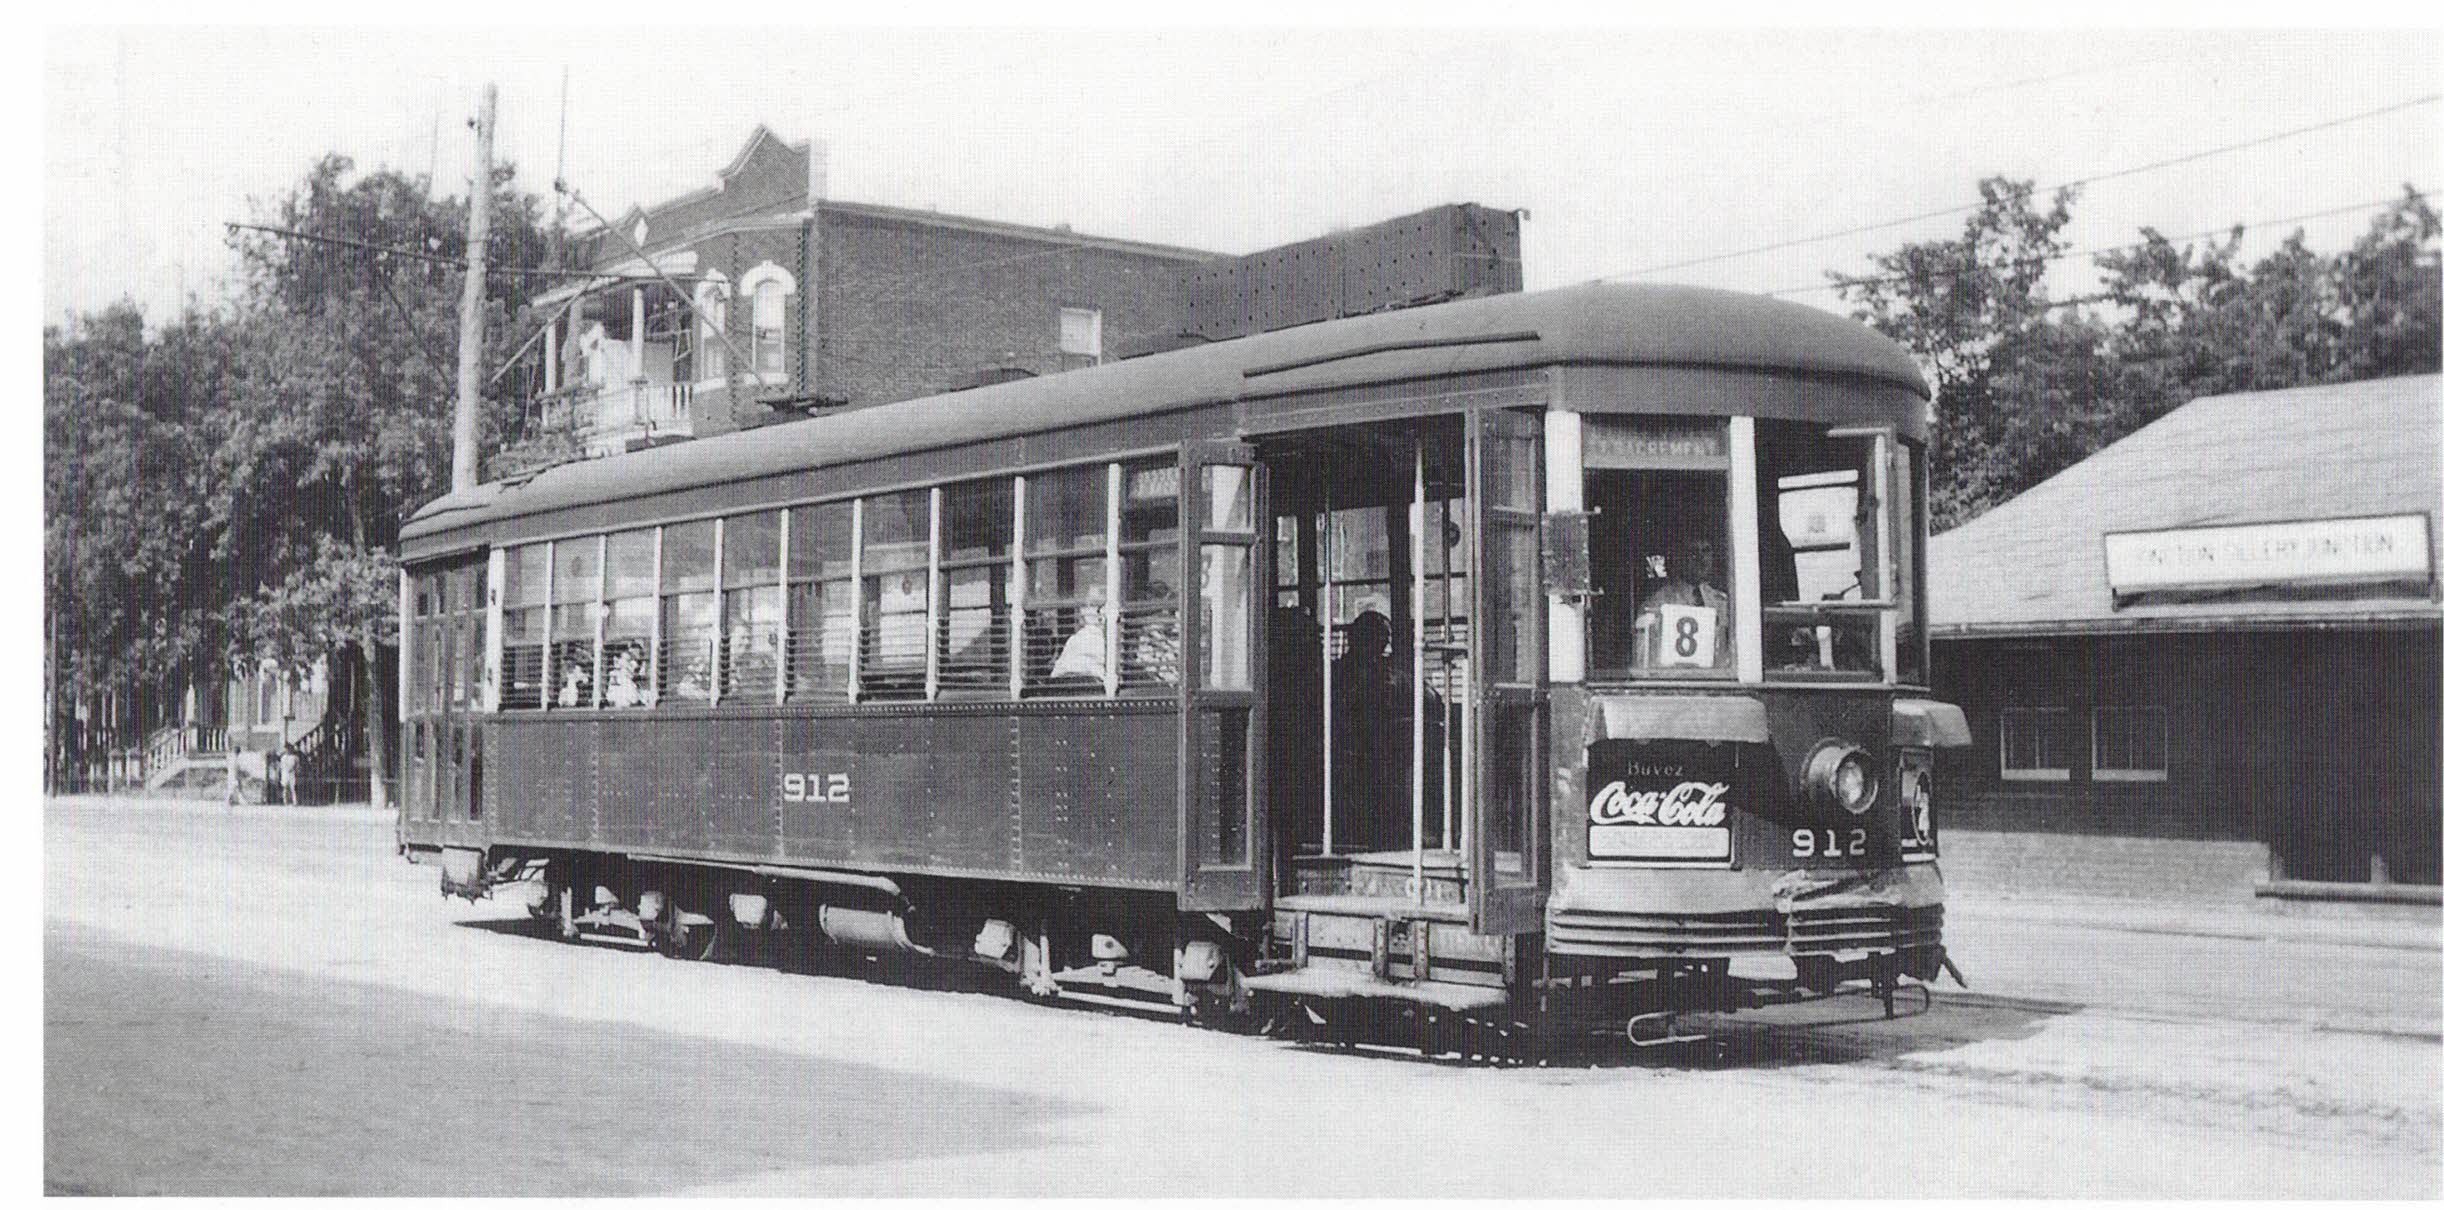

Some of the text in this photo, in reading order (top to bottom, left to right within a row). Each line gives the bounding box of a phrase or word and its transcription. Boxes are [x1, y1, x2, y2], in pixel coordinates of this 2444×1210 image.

[1675, 616, 1699, 657] 8
[784, 773, 850, 802] 912
[1590, 781, 1729, 826] Coca-Cola
[1792, 828, 1866, 857] 912
